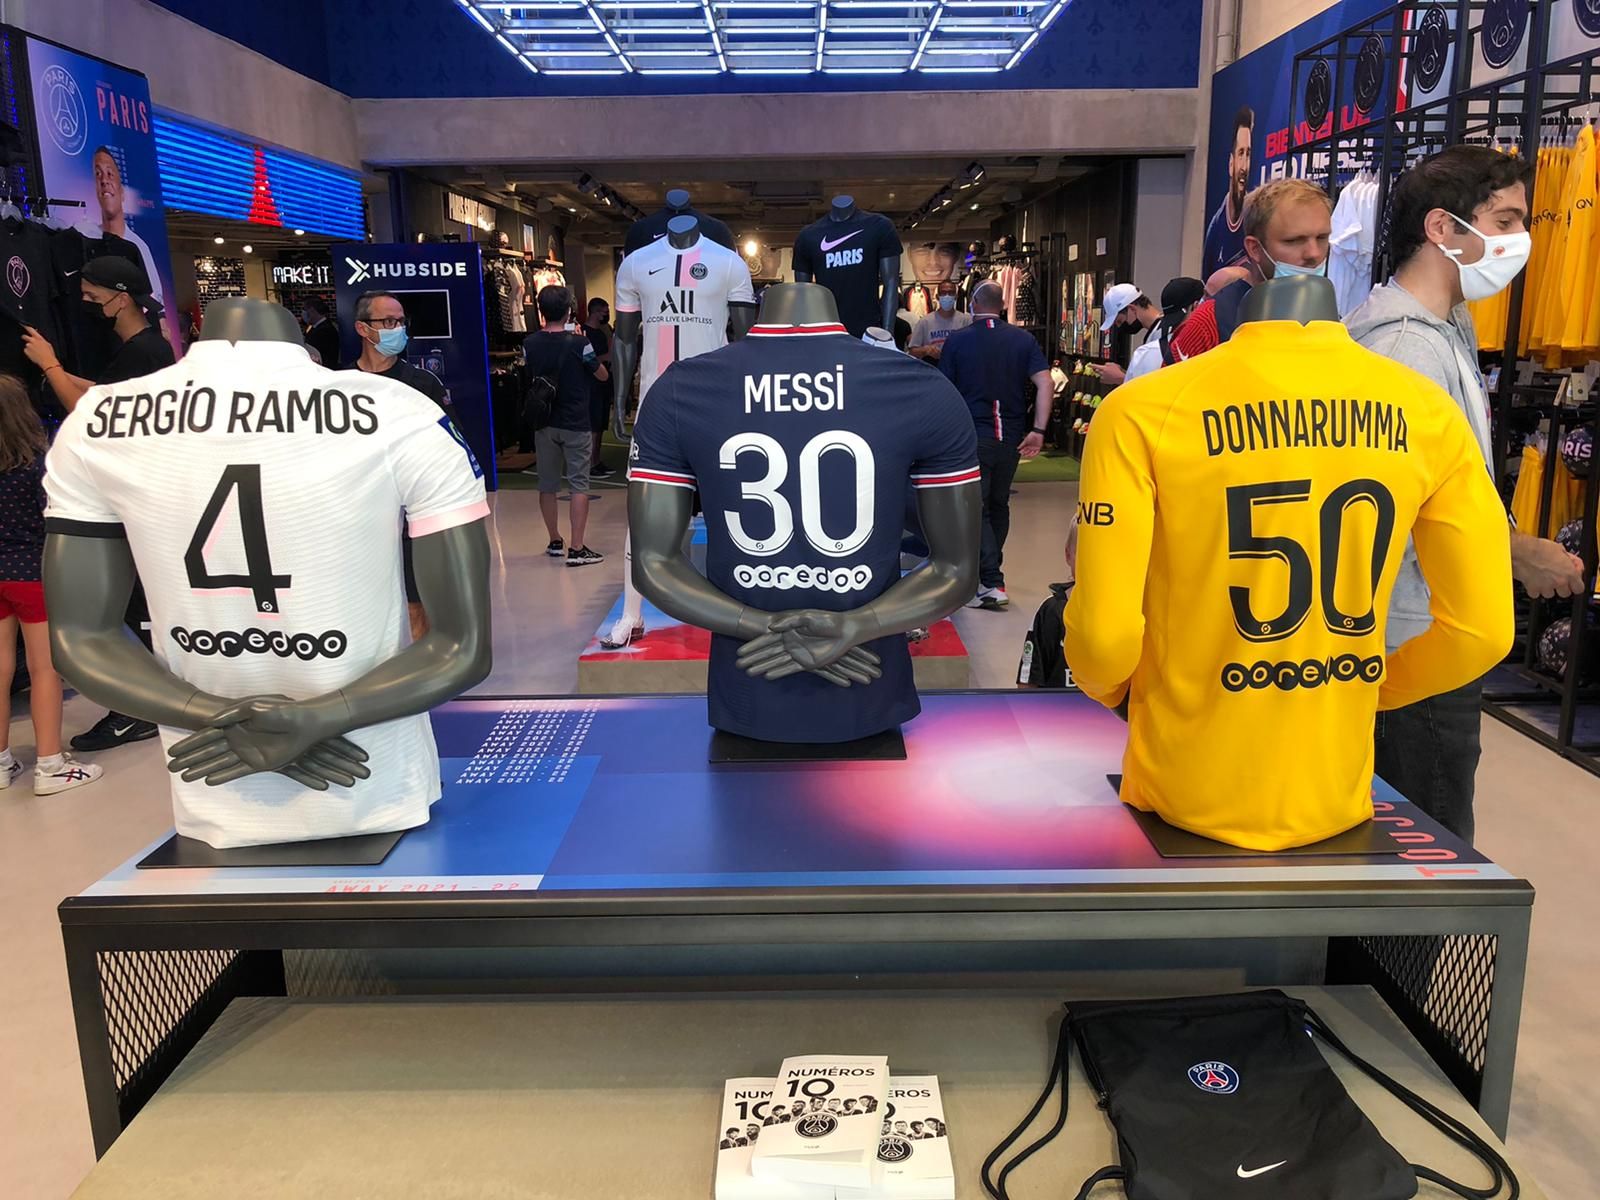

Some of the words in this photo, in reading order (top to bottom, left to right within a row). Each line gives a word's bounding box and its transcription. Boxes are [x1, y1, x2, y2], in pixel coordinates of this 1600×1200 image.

[96, 87, 148, 133] PARIS
[374, 262, 467, 277] HUBSIDE
[826, 248, 863, 268] PARIS
[273, 266, 313, 284] MAKE
[317, 266, 329, 284] IT
[227, 388, 378, 435] RAMOS
[1202, 399, 1408, 456] DONNARUMMA
[719, 430, 876, 557] 30
[184, 464, 291, 613] 4
[1226, 478, 1396, 643] 50
[736, 567, 870, 591] ooredoo
[173, 628, 345, 659] ooredoo
[1223, 656, 1382, 690] ooreoo
[491, 882, 520, 892] 22
[788, 1066, 875, 1078] NUMÉROS
[1193, 1063, 1225, 1074] PARIS
[786, 1078, 835, 1098] 10
